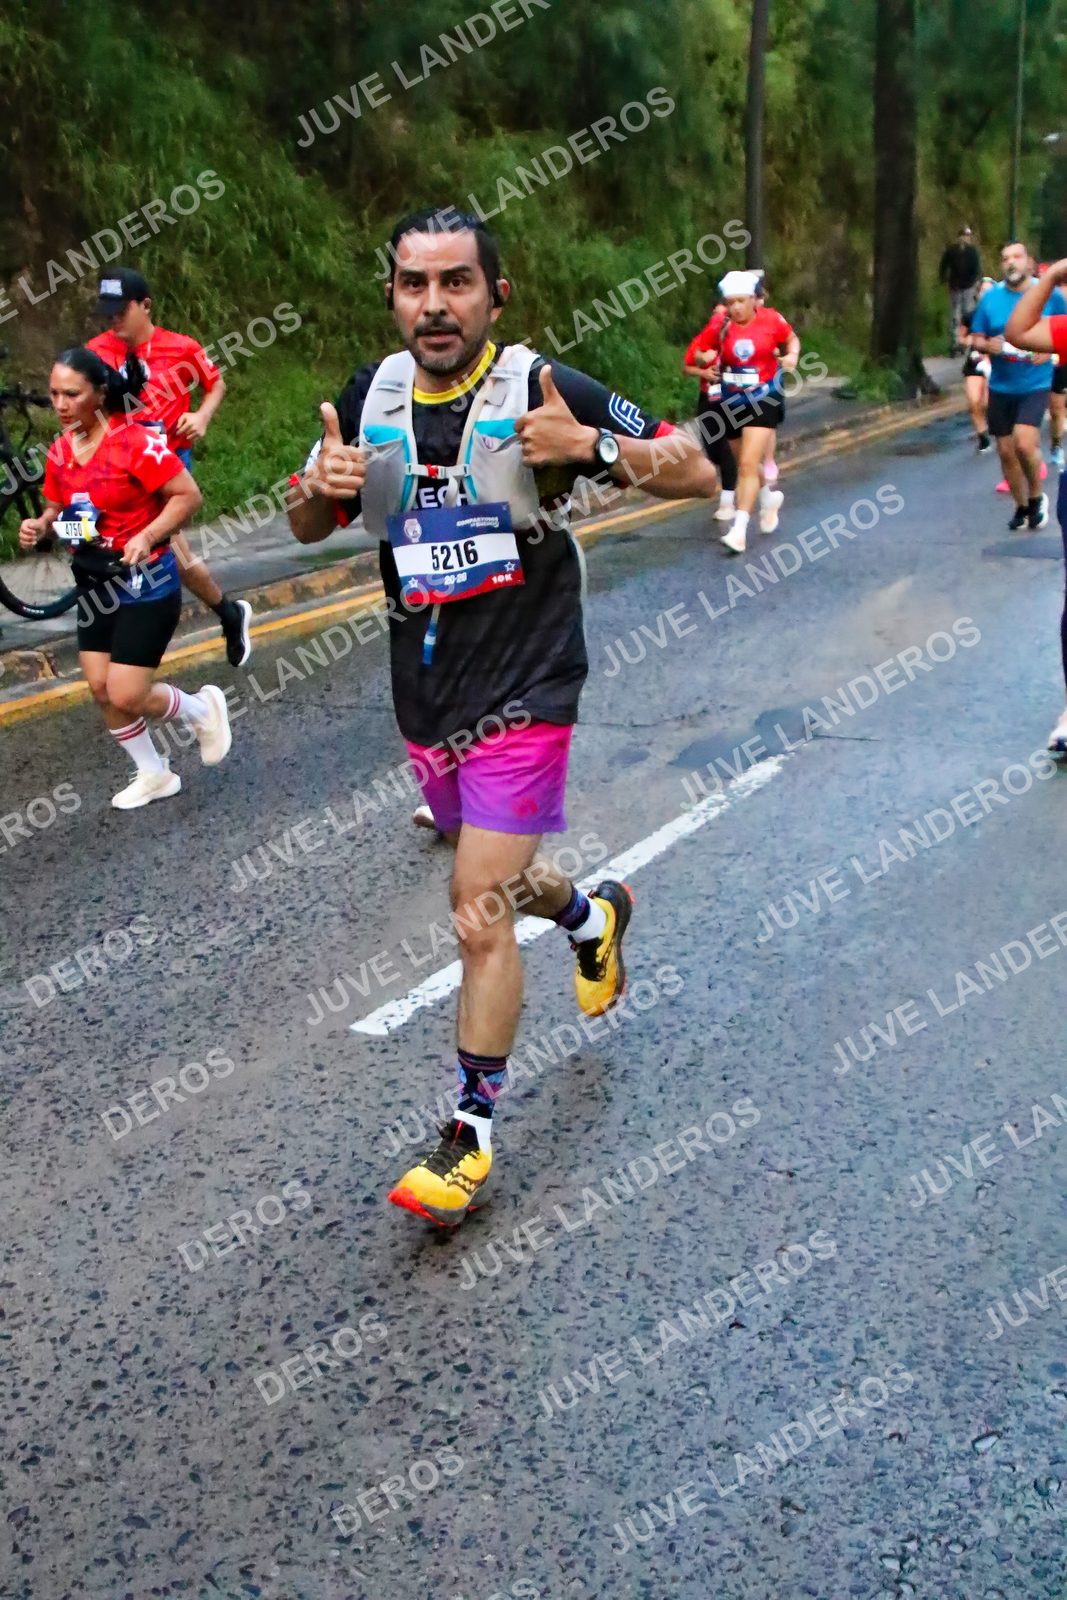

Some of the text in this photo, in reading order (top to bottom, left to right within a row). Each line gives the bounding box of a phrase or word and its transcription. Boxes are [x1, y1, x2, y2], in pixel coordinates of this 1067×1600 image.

[65, 522, 83, 537] 4750
[431, 540, 479, 571] 5216
[491, 573, 513, 583] 10K
